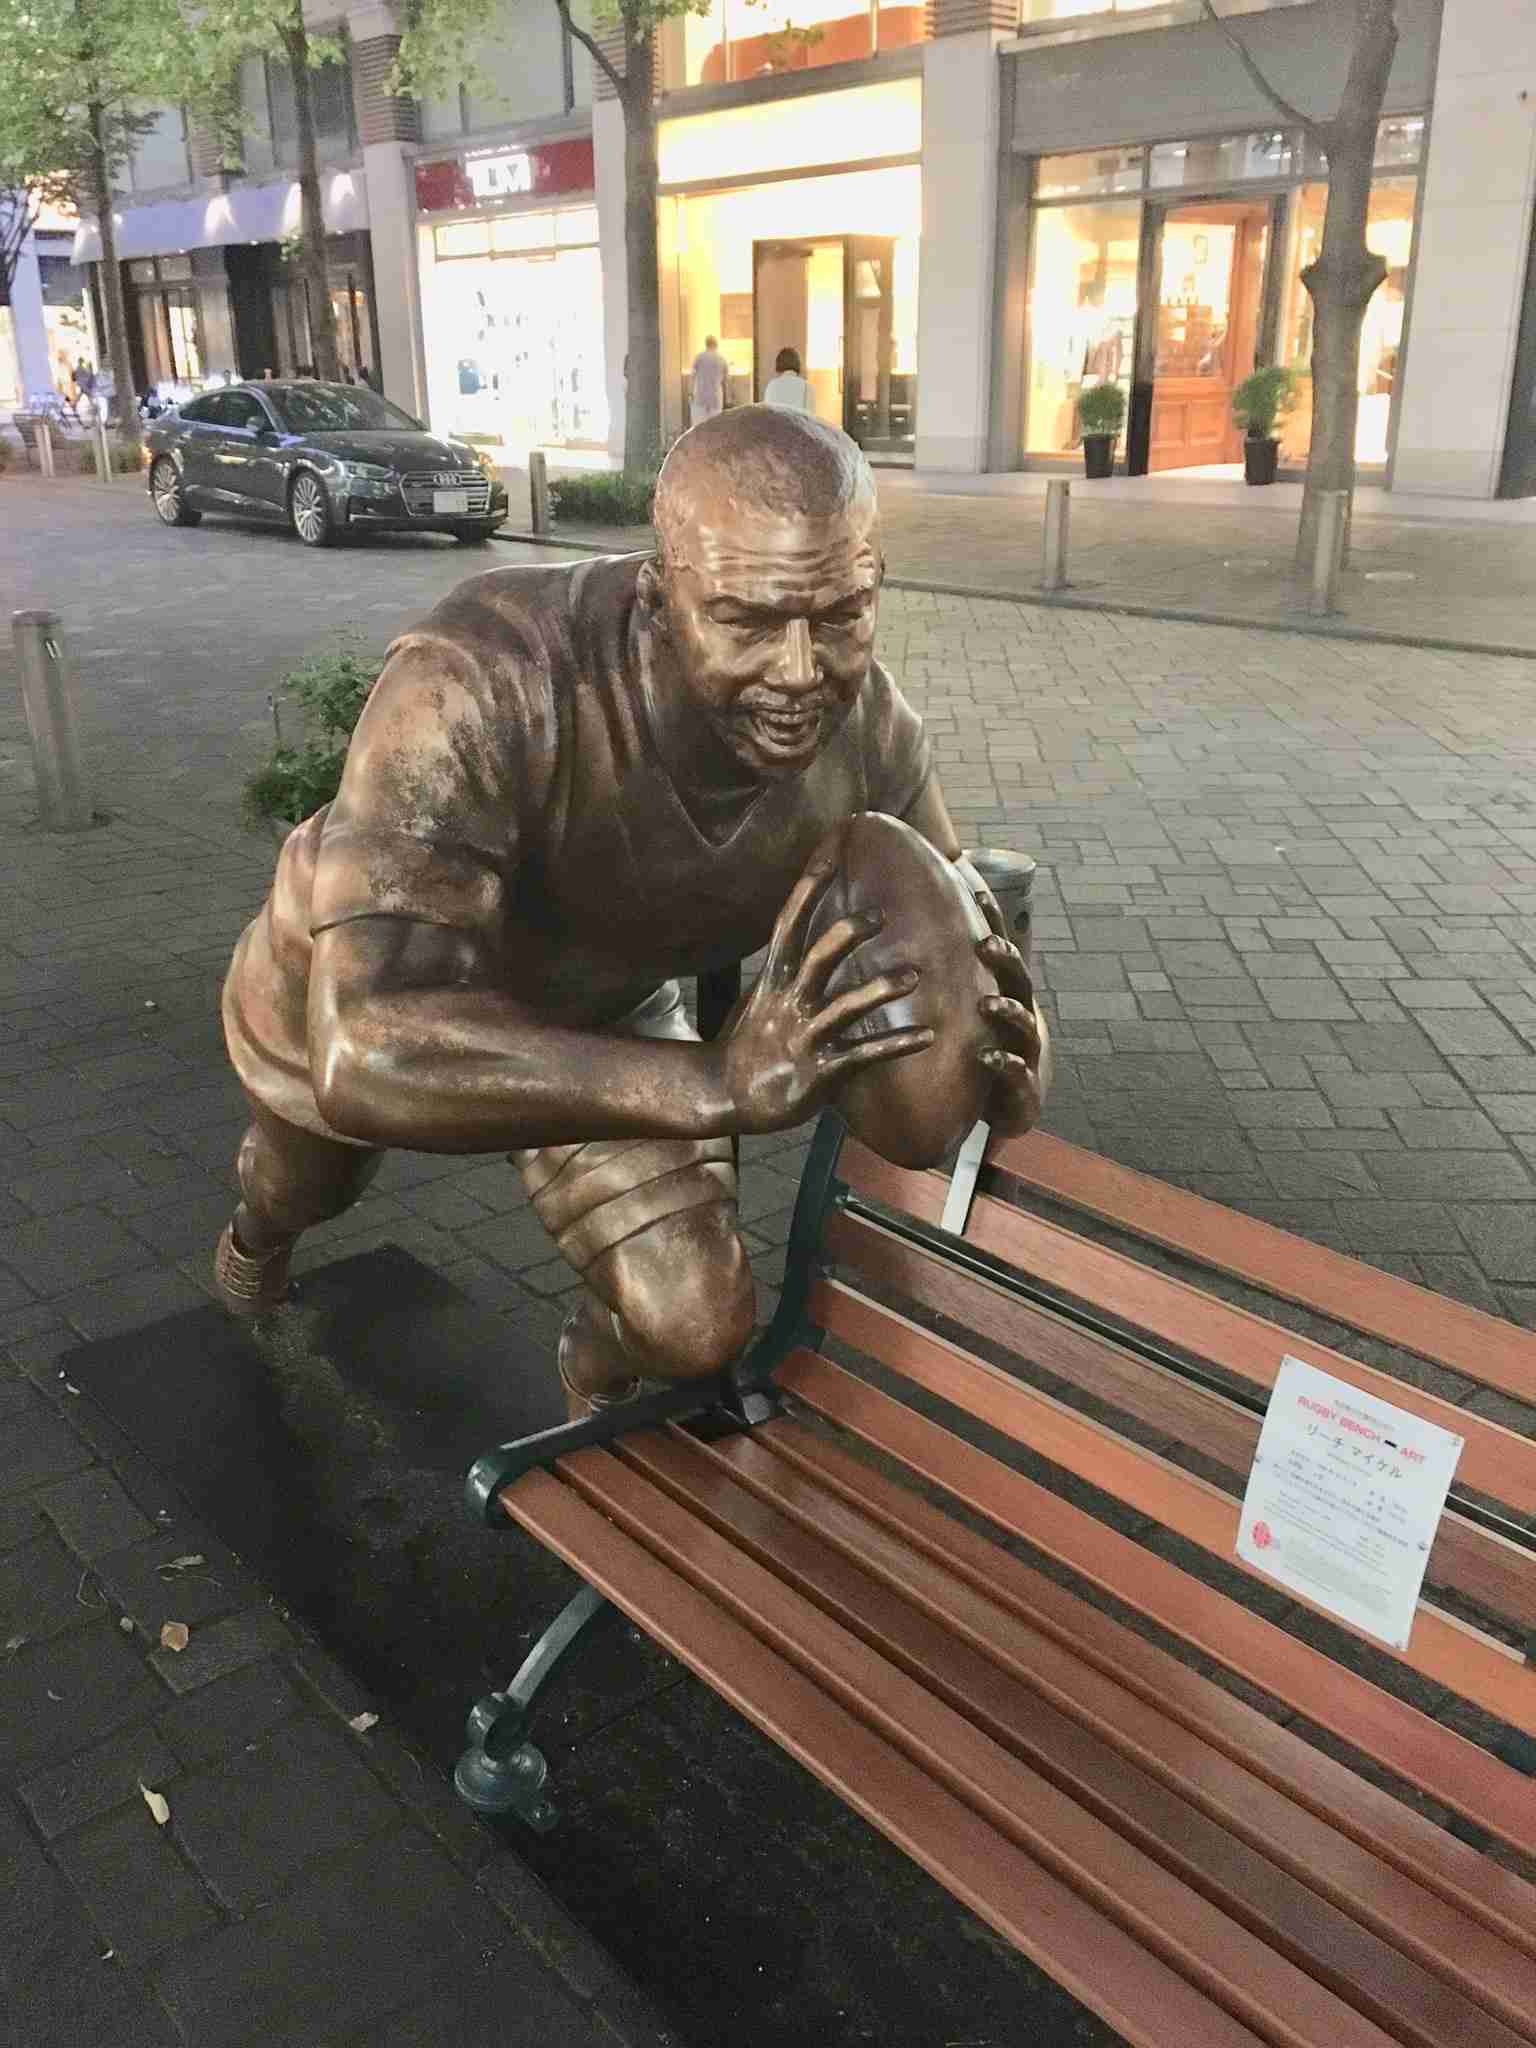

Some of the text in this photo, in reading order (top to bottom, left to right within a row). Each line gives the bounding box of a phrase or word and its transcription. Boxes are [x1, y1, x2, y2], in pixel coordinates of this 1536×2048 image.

[1297, 1396, 1337, 1419] RUGBY
[1340, 1416, 1381, 1443] BENCH
[1400, 1447, 1426, 1464] ART
